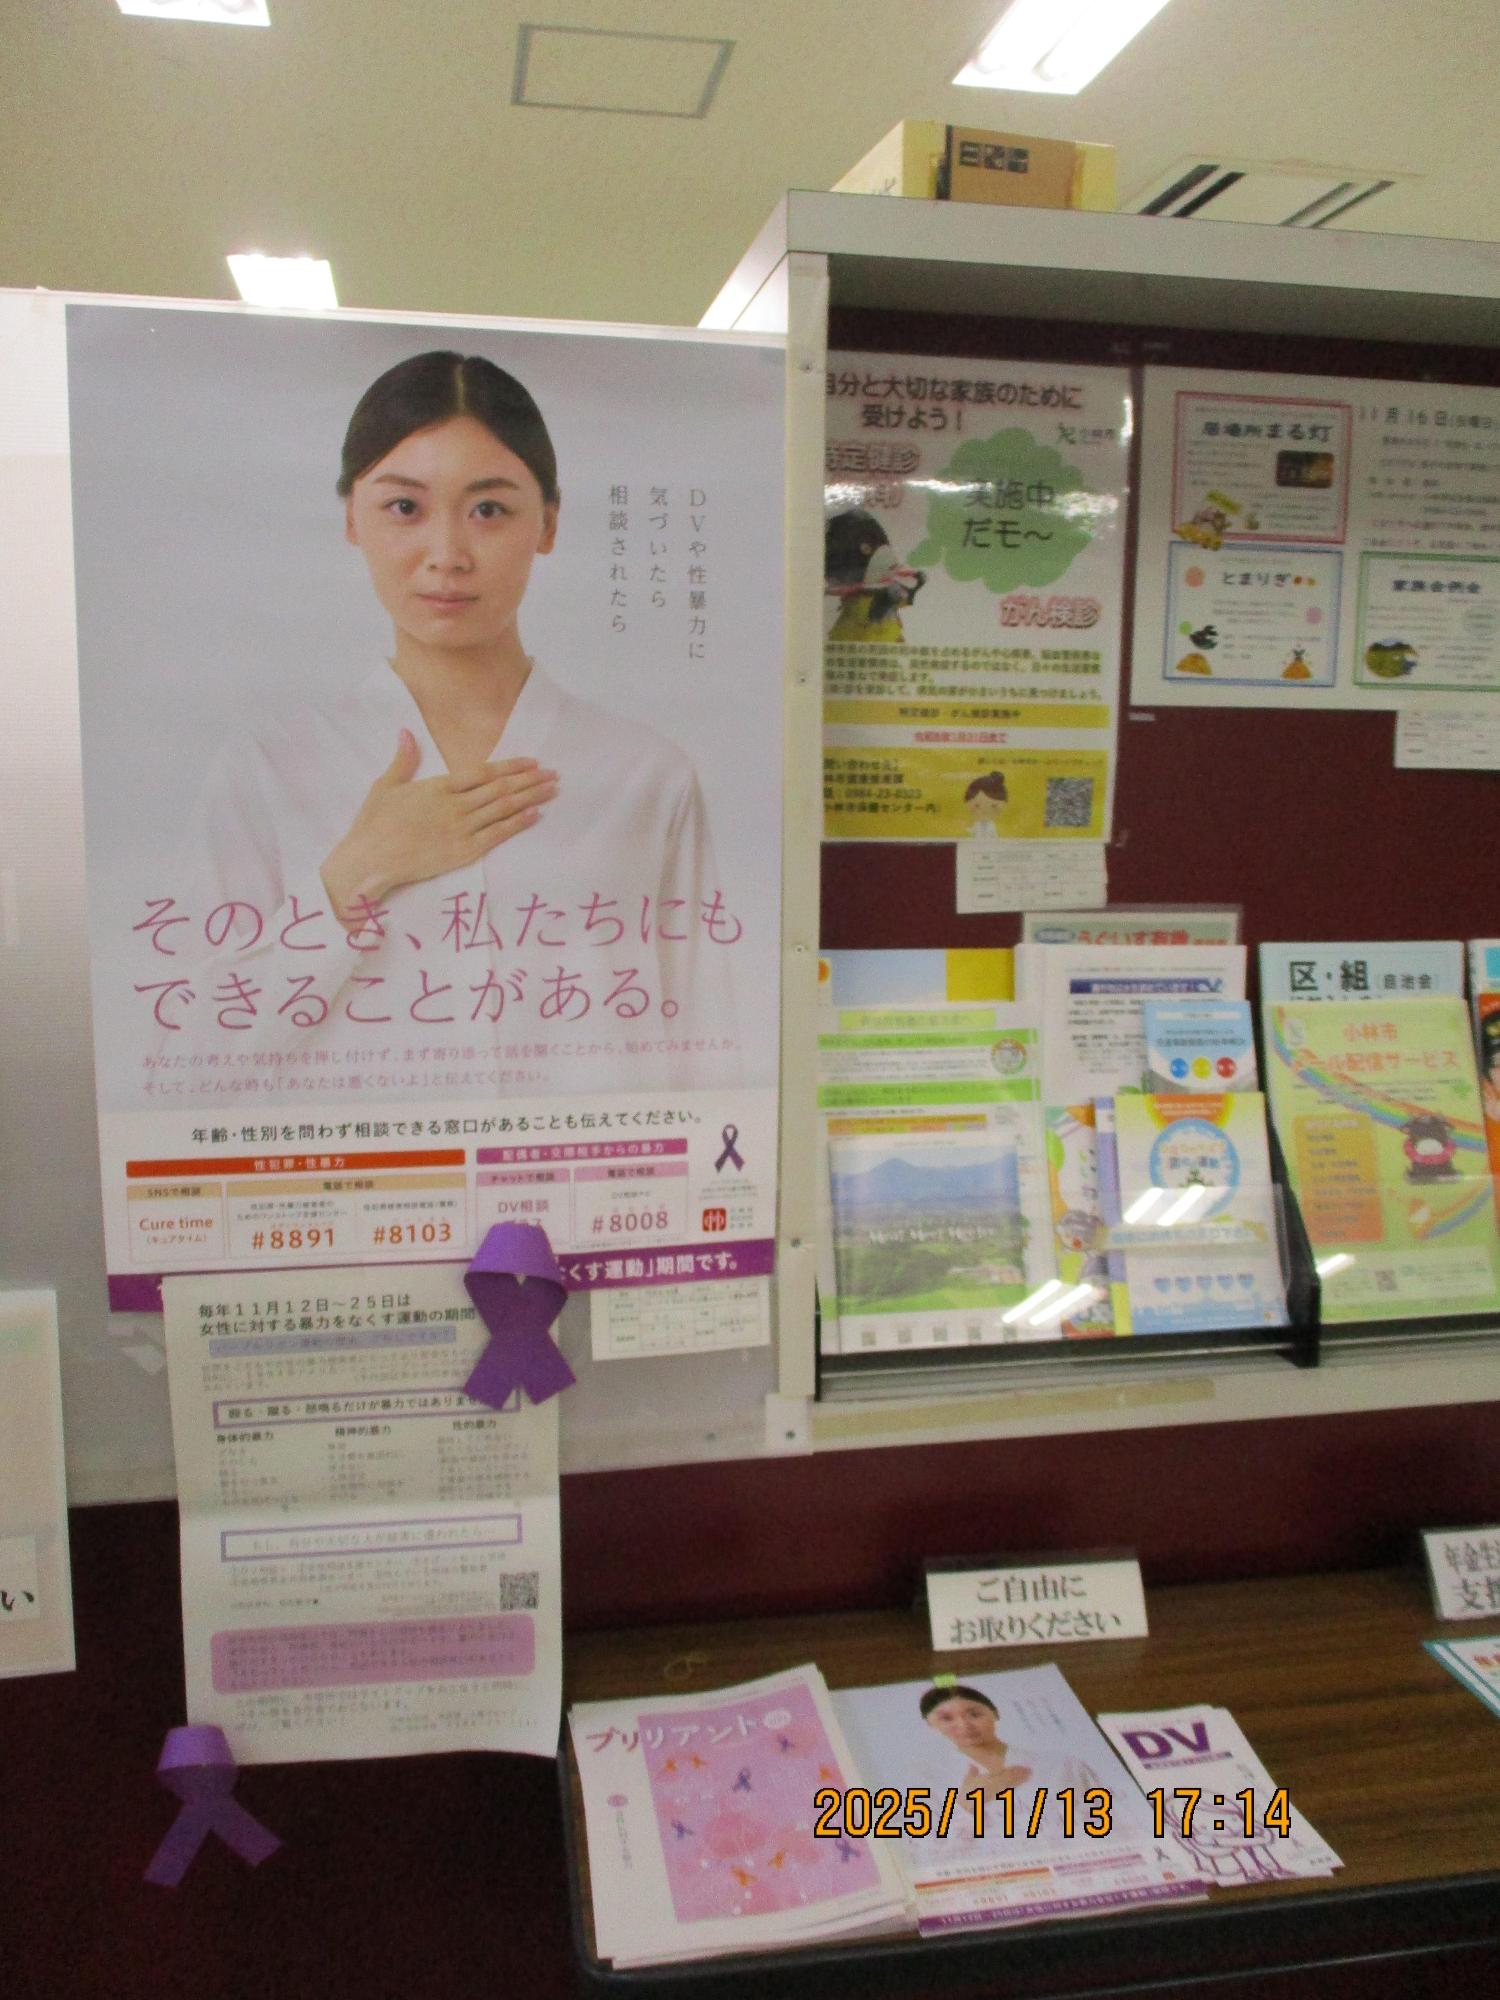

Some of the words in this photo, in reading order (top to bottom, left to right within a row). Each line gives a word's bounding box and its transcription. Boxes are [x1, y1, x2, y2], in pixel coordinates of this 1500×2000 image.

[609, 485, 628, 632] 相談されたら
[649, 486, 668, 608] 気づいたら
[689, 489, 706, 659] DVや性暴力に
[133, 890, 742, 955] そのとき、私たちにも
[1290, 960, 1370, 991] 区・組
[133, 966, 679, 1030] できることがある。
[191, 1109, 702, 1144] 年齢・性別を問わず相談できる窓口があることも伝えてください。
[497, 1199, 550, 1214] DV相談
[592, 1211, 669, 1234] #8008
[138, 1218, 173, 1232] Cure
[177, 1216, 214, 1231] time
[251, 1228, 335, 1250] #8891
[373, 1222, 451, 1246] #8103
[561, 1252, 738, 1281] くす運動」期間です。
[199, 1306, 477, 1336] 女性に対する暴力をなくす運動の期間
[976, 1573, 1088, 1604] ご自由に
[950, 1609, 1121, 1645] お取りください
[586, 1714, 758, 1753] ブリリアント
[1121, 1721, 1211, 1760] DV
